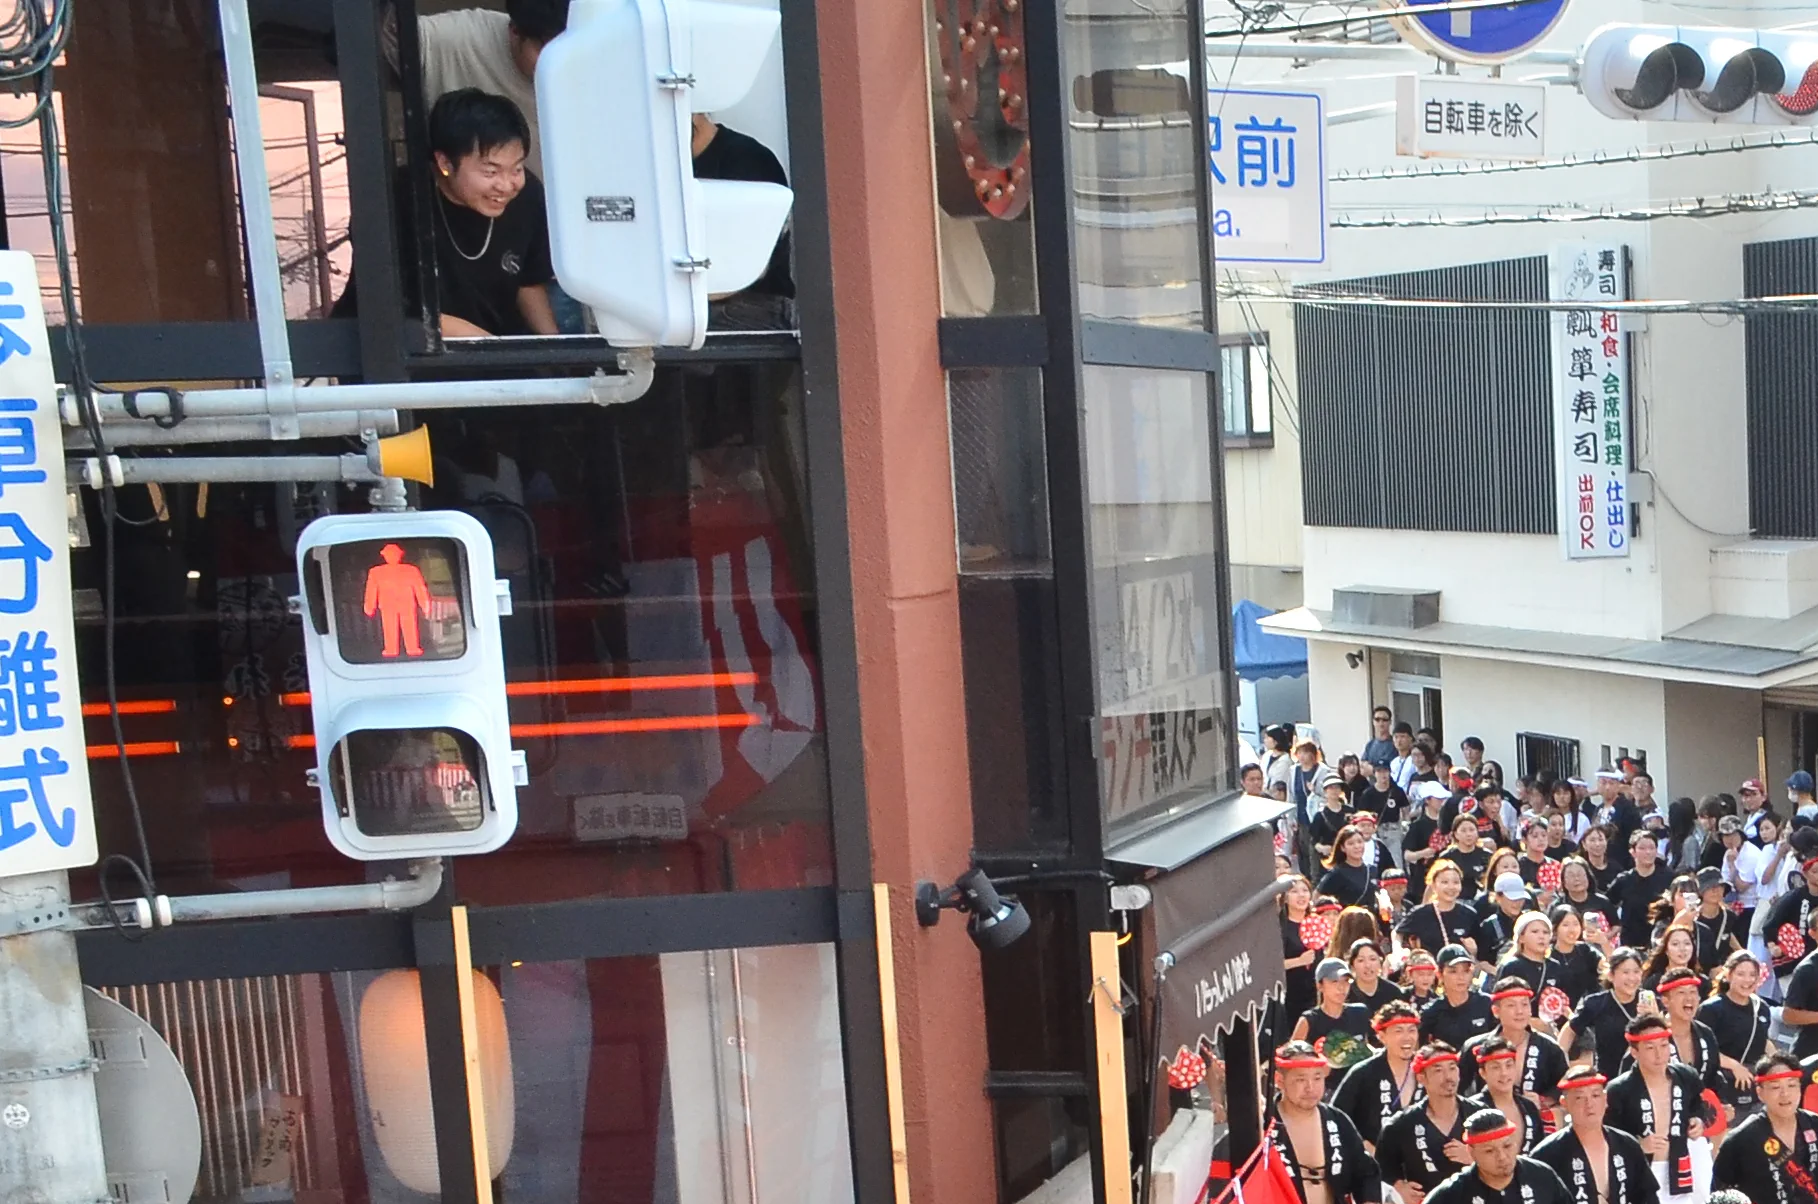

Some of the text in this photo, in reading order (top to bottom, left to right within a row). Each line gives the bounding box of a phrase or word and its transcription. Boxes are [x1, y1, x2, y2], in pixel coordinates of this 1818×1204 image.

[1424, 97, 1538, 139] 自転車を除く
[1598, 249, 1625, 549] 寿司和食・会席料理・仕出し
[1577, 473, 1595, 550] 出前OK
